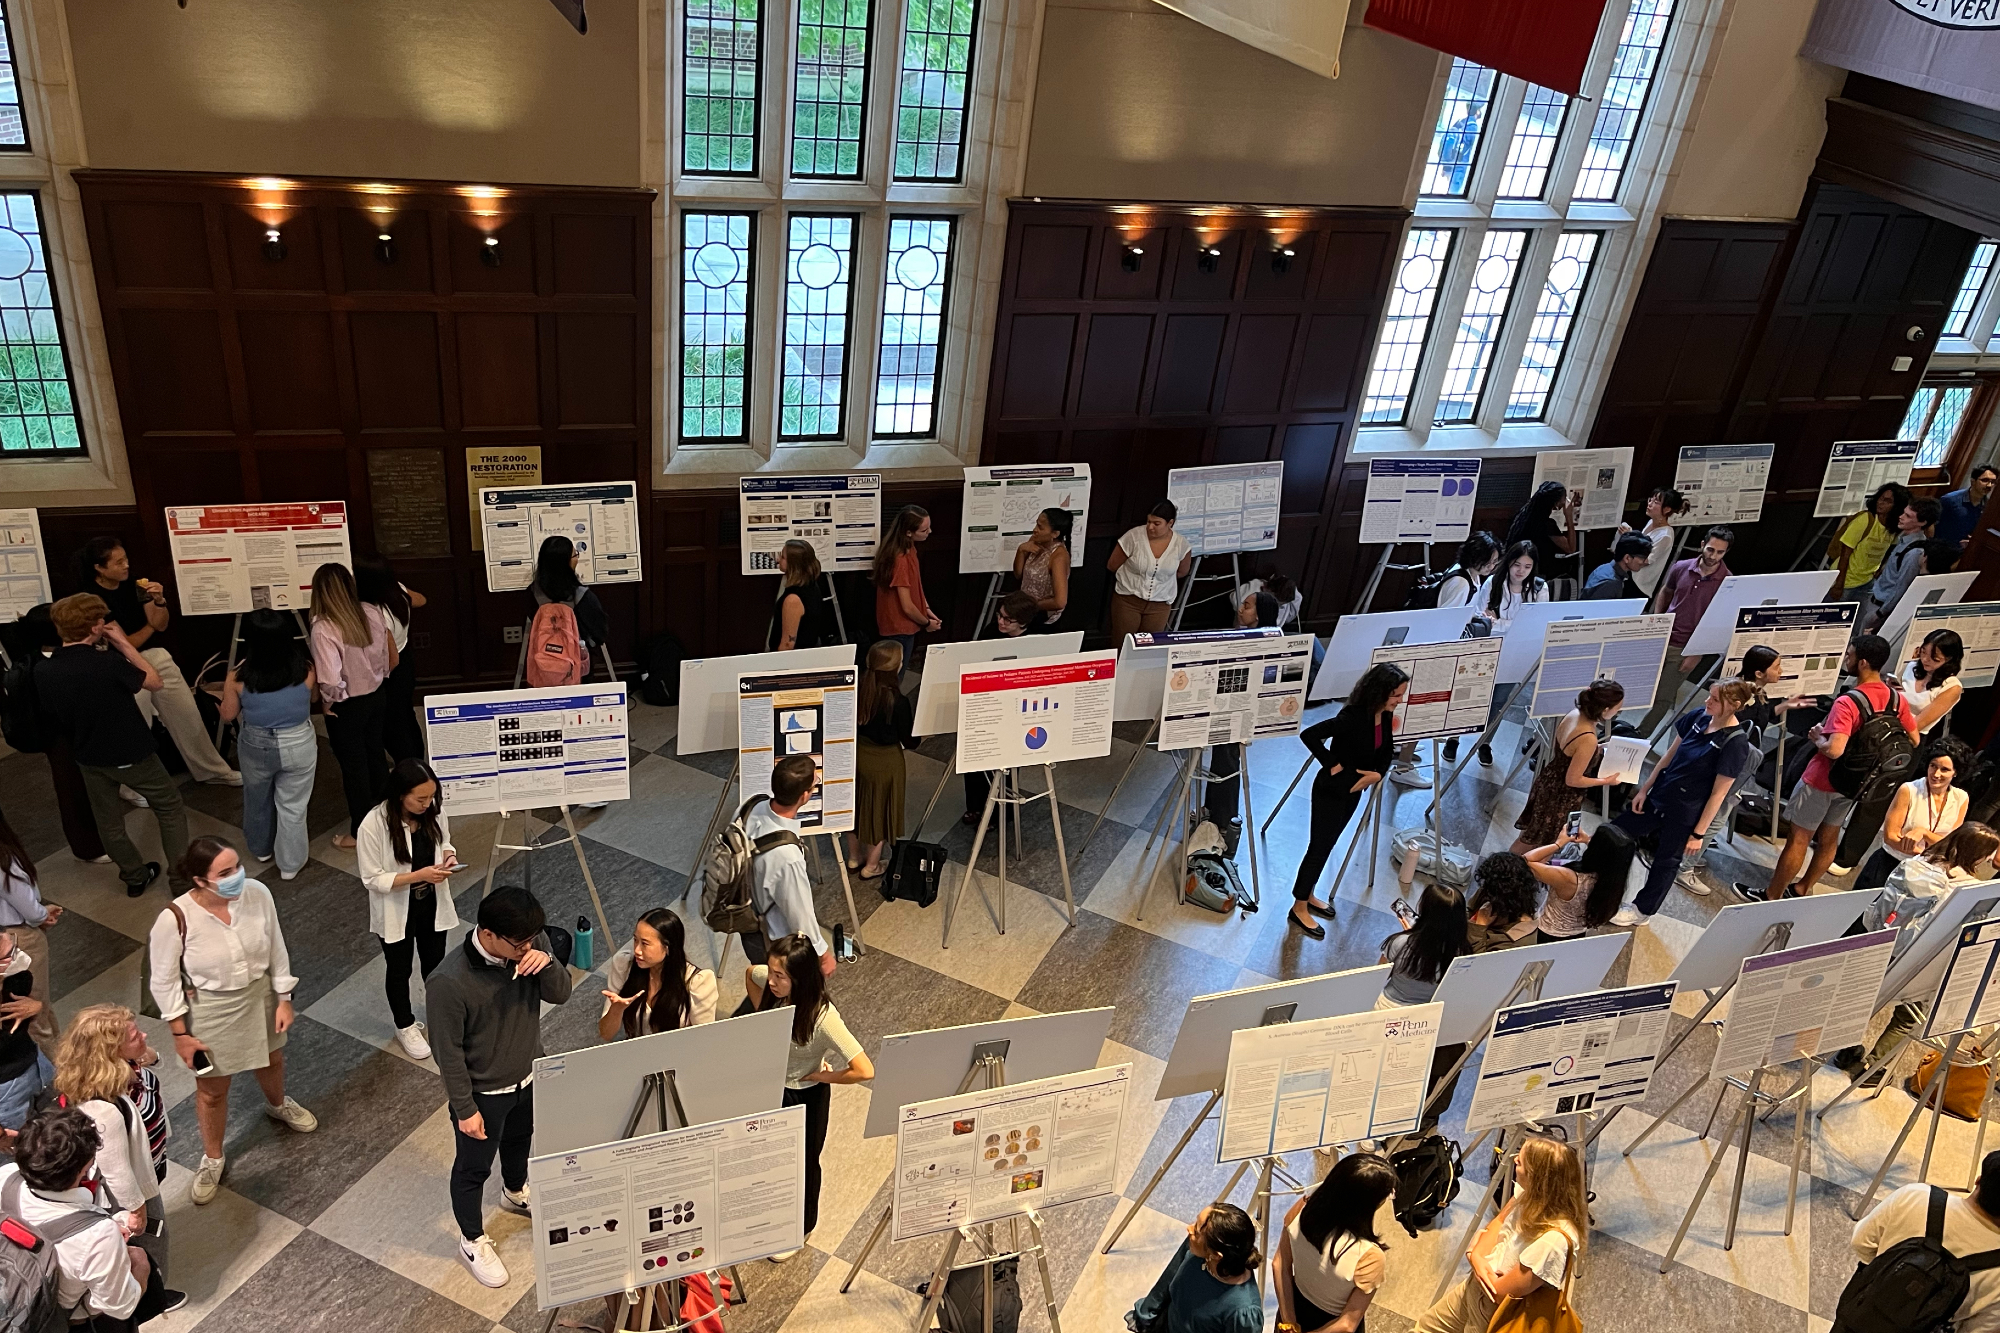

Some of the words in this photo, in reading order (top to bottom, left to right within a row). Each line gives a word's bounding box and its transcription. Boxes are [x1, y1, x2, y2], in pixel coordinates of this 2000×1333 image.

[480, 455, 499, 463] THE
[470, 463, 538, 472] RESTORATION
[1402, 1020, 1428, 1030] Penn
[1325, 1029, 1340, 1037] Blood
[1400, 1028, 1437, 1038] Medicine
